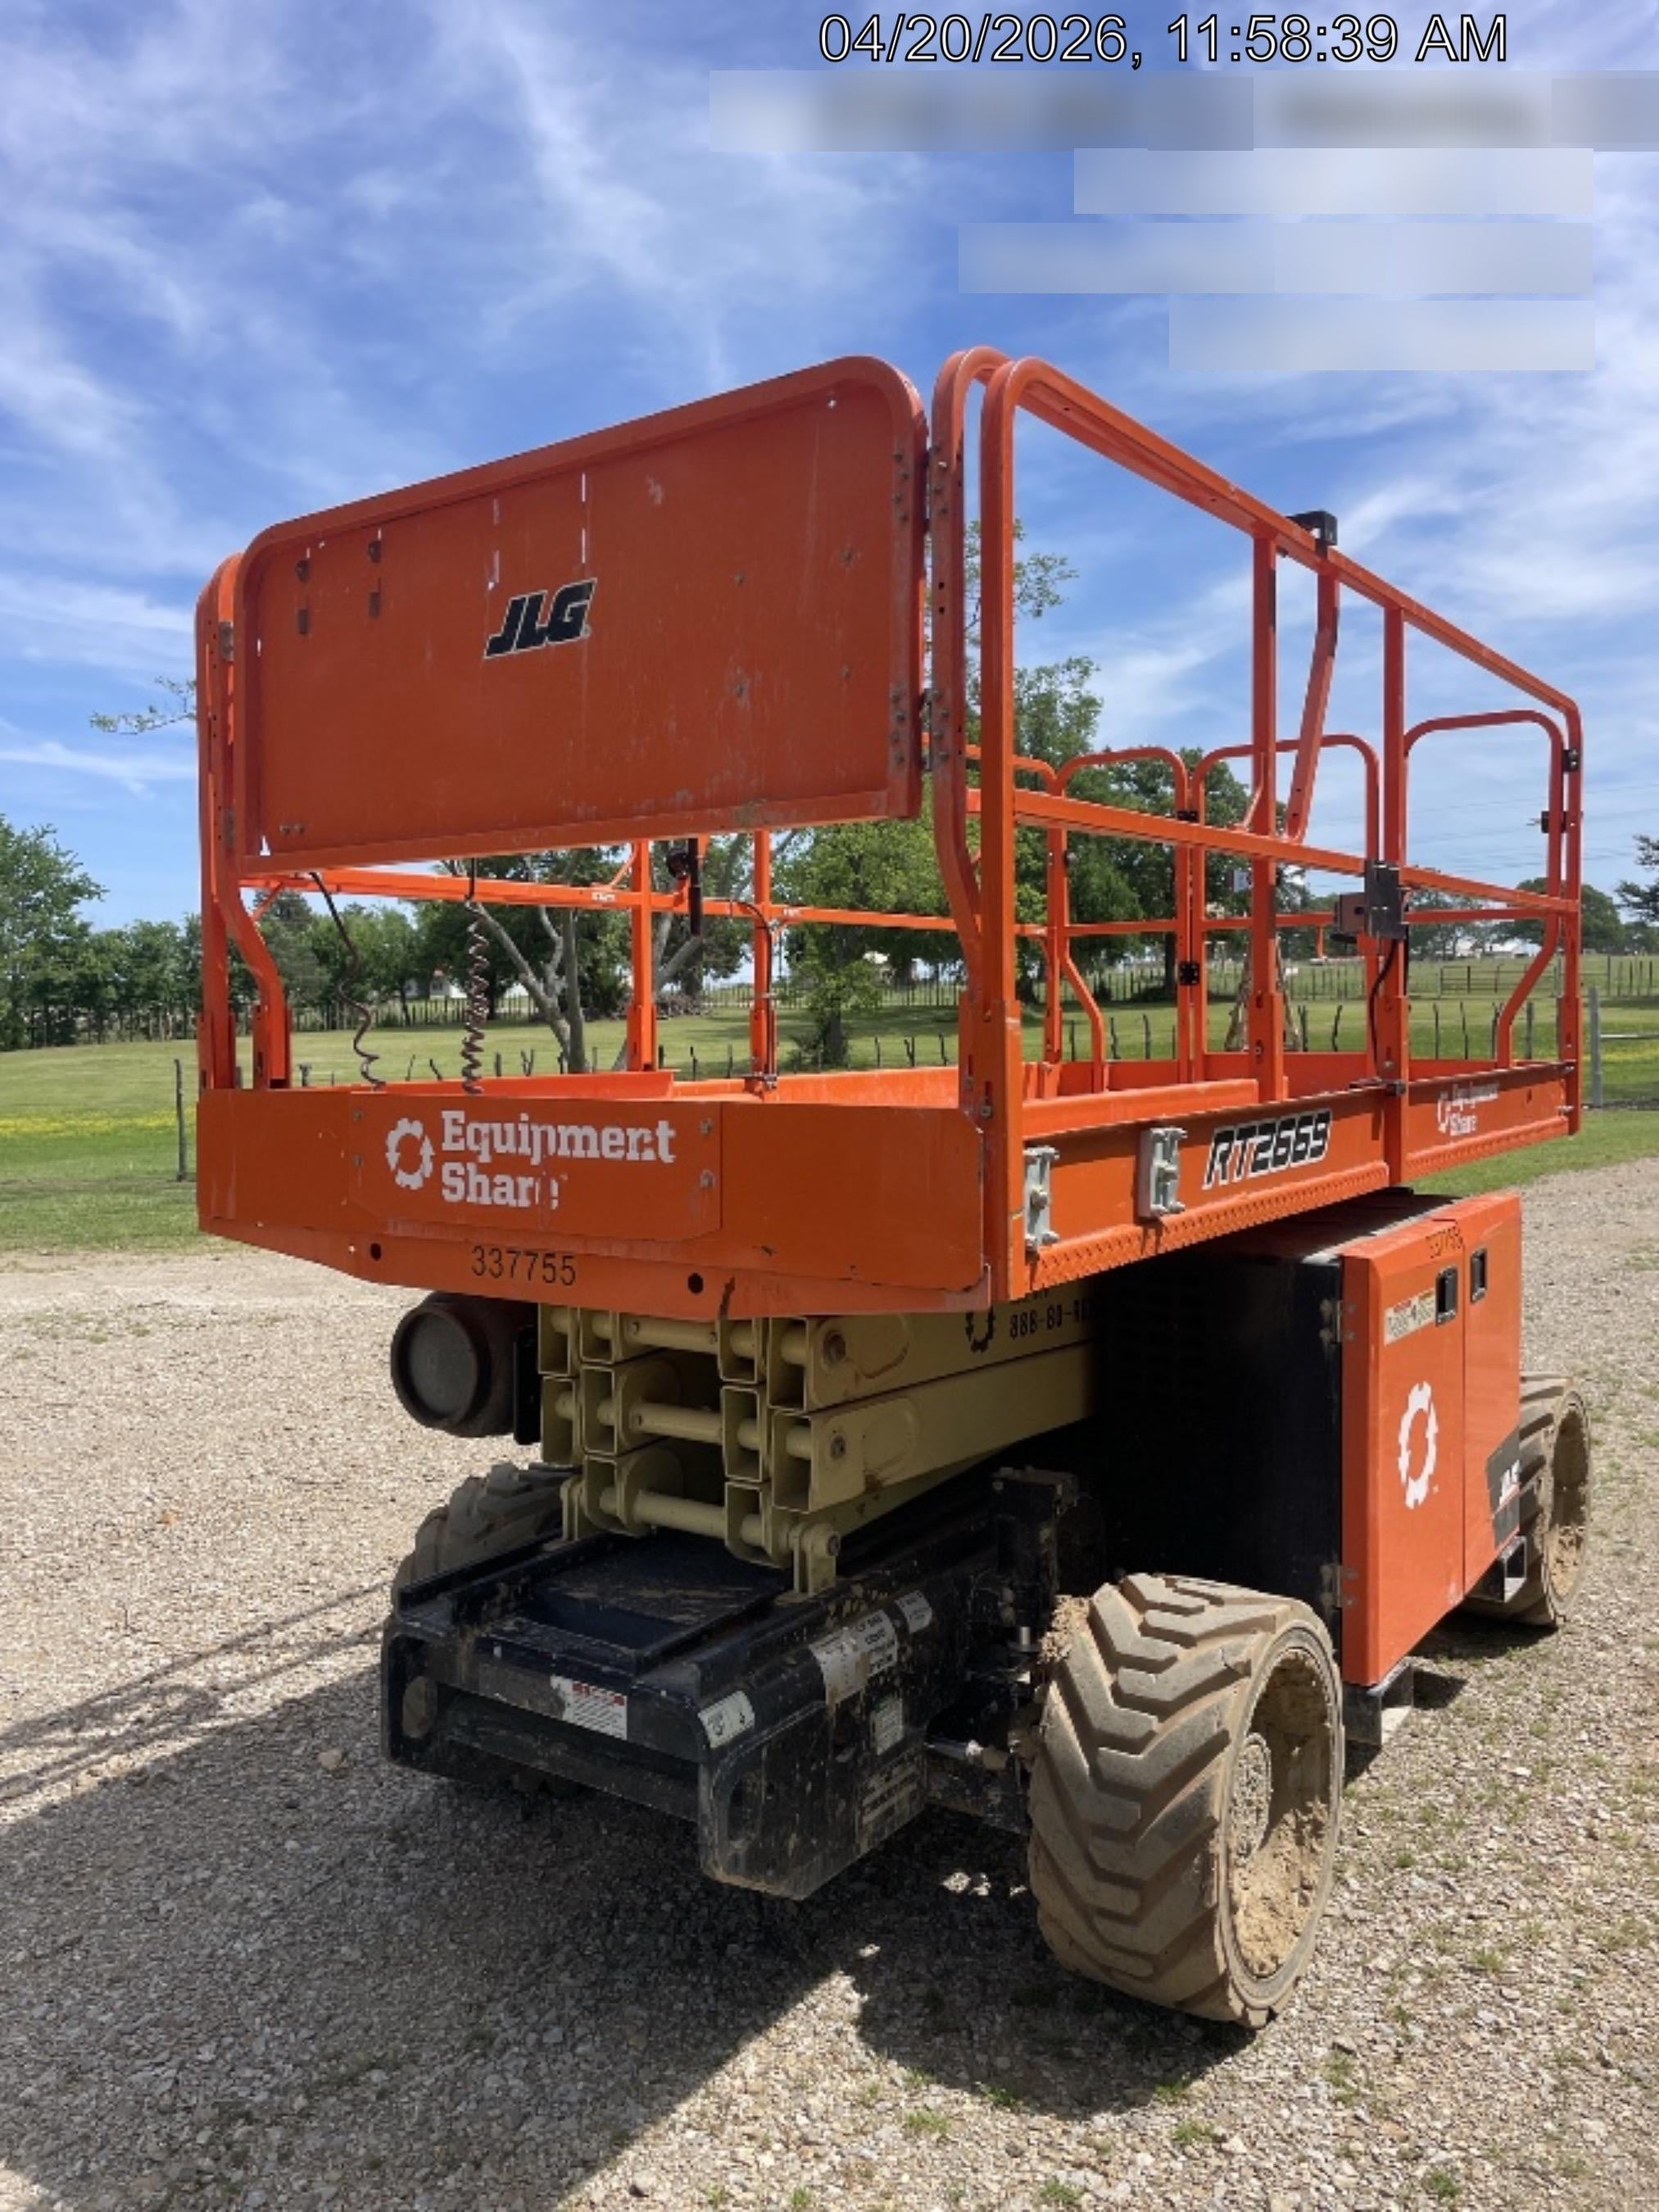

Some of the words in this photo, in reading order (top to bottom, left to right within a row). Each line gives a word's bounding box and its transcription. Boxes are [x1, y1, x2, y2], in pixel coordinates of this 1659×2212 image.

[483, 577, 597, 660] JLG
[441, 1109, 675, 1164] Equipment
[1202, 1108, 1333, 1190] RT2669
[471, 1245, 577, 1287] 337755
